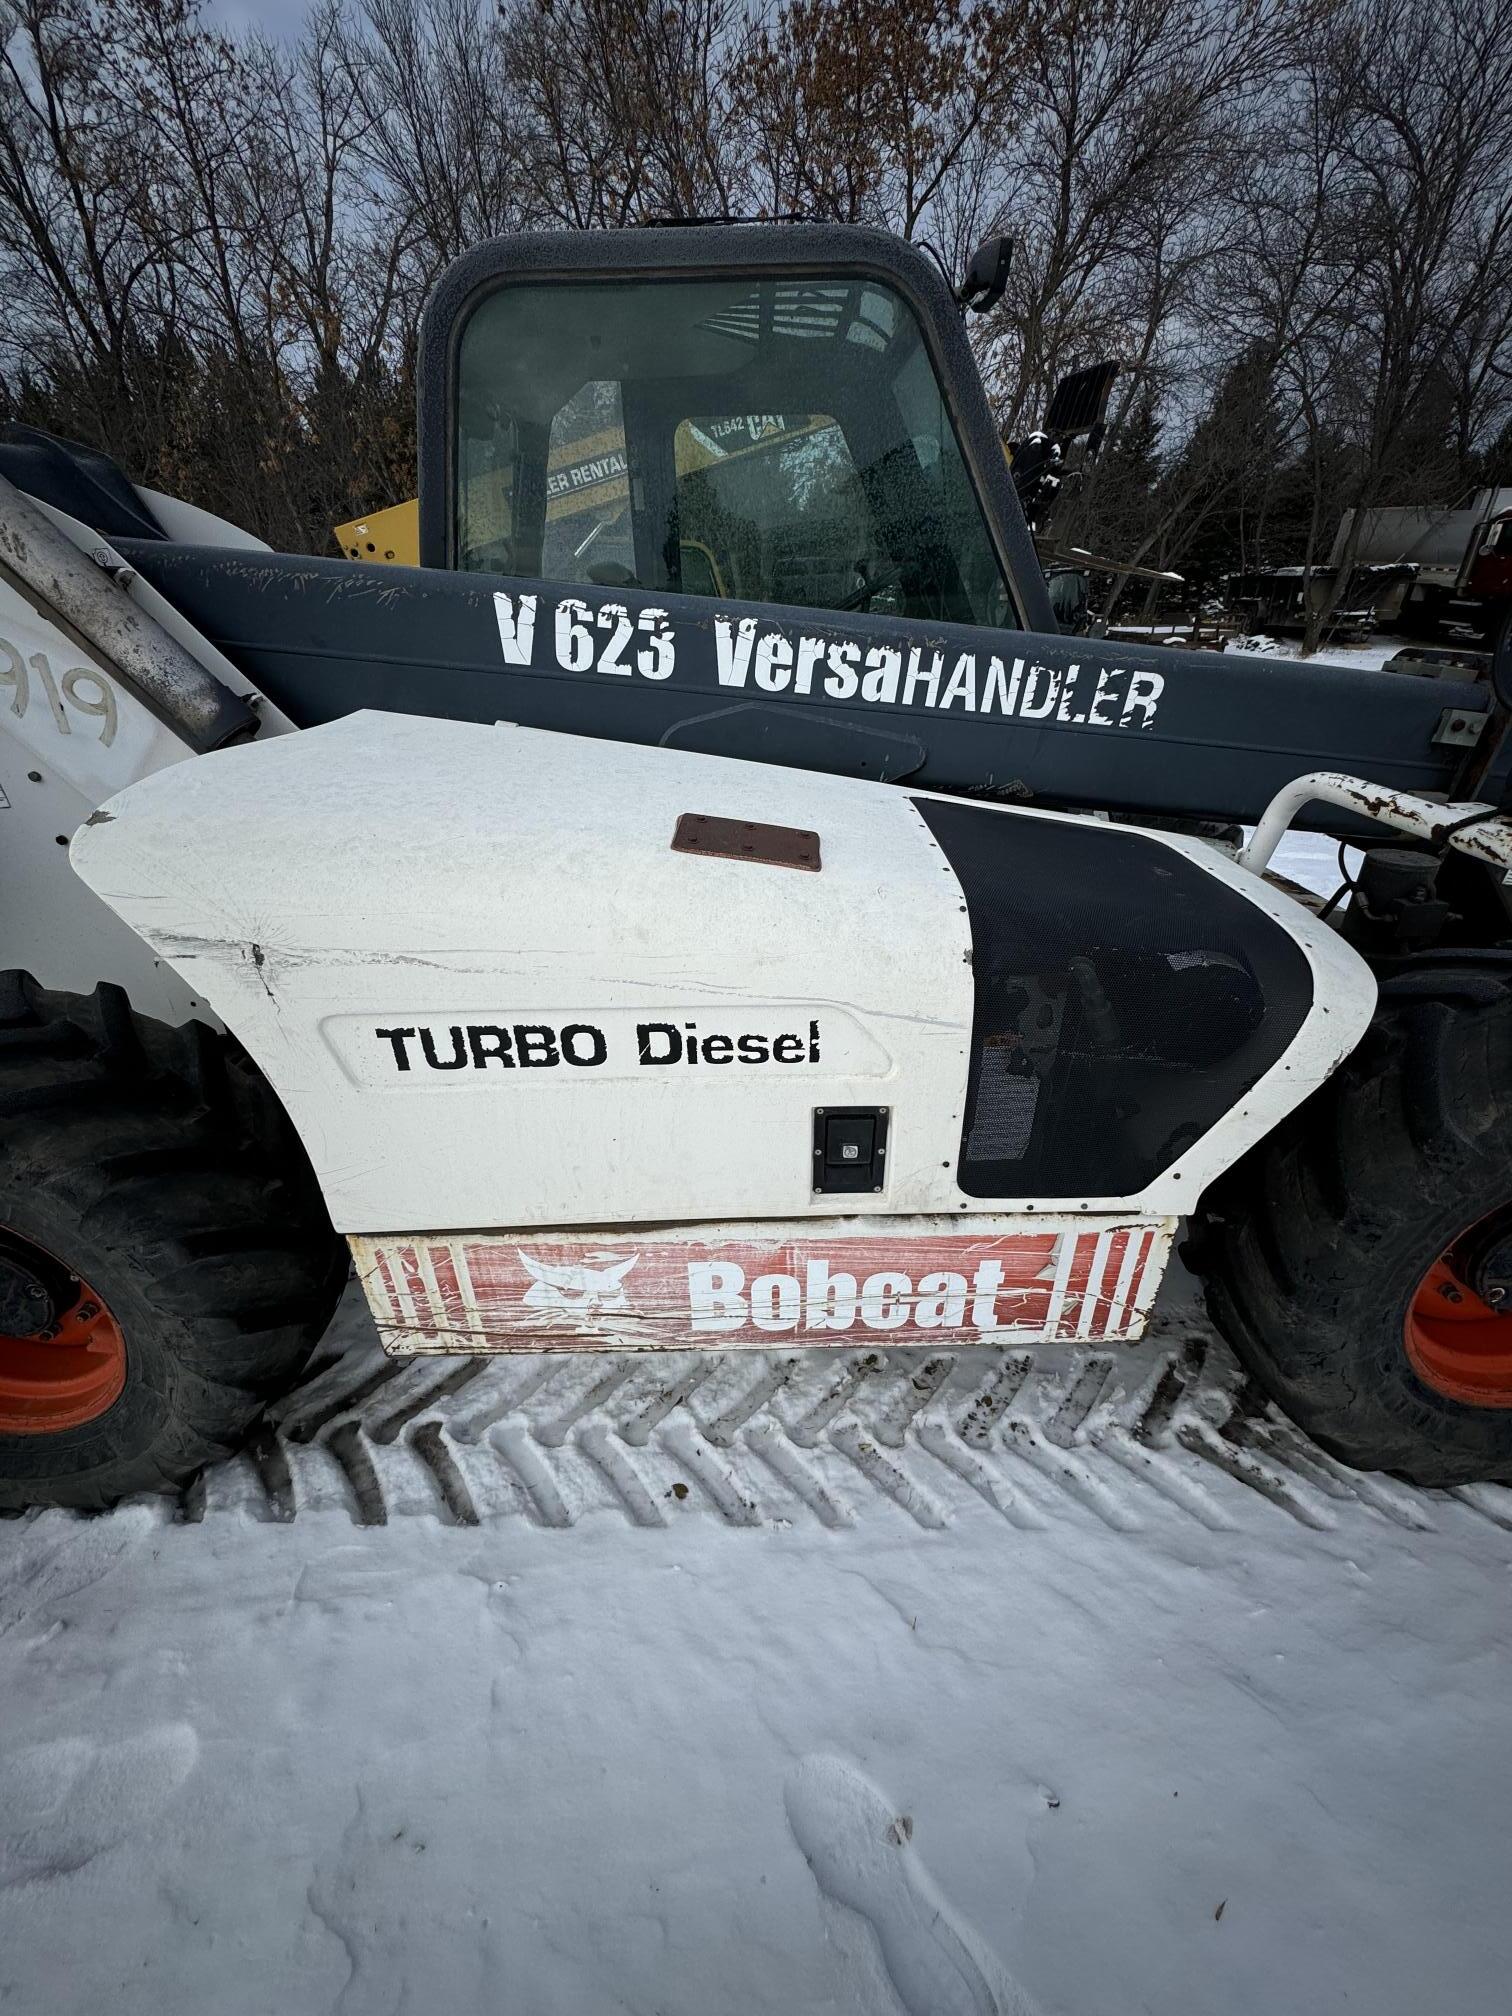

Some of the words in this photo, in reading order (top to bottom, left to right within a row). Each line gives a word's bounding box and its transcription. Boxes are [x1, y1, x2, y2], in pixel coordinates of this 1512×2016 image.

[547, 473, 569, 495] ER
[570, 453, 628, 486] RENTAL
[493, 592, 538, 665] V
[555, 599, 675, 681] 623
[714, 613, 1164, 729] VersaHANDLER
[375, 1023, 608, 1072] TURBO
[637, 1019, 821, 1066] Diesel
[687, 1259, 1006, 1332] Bobcat
